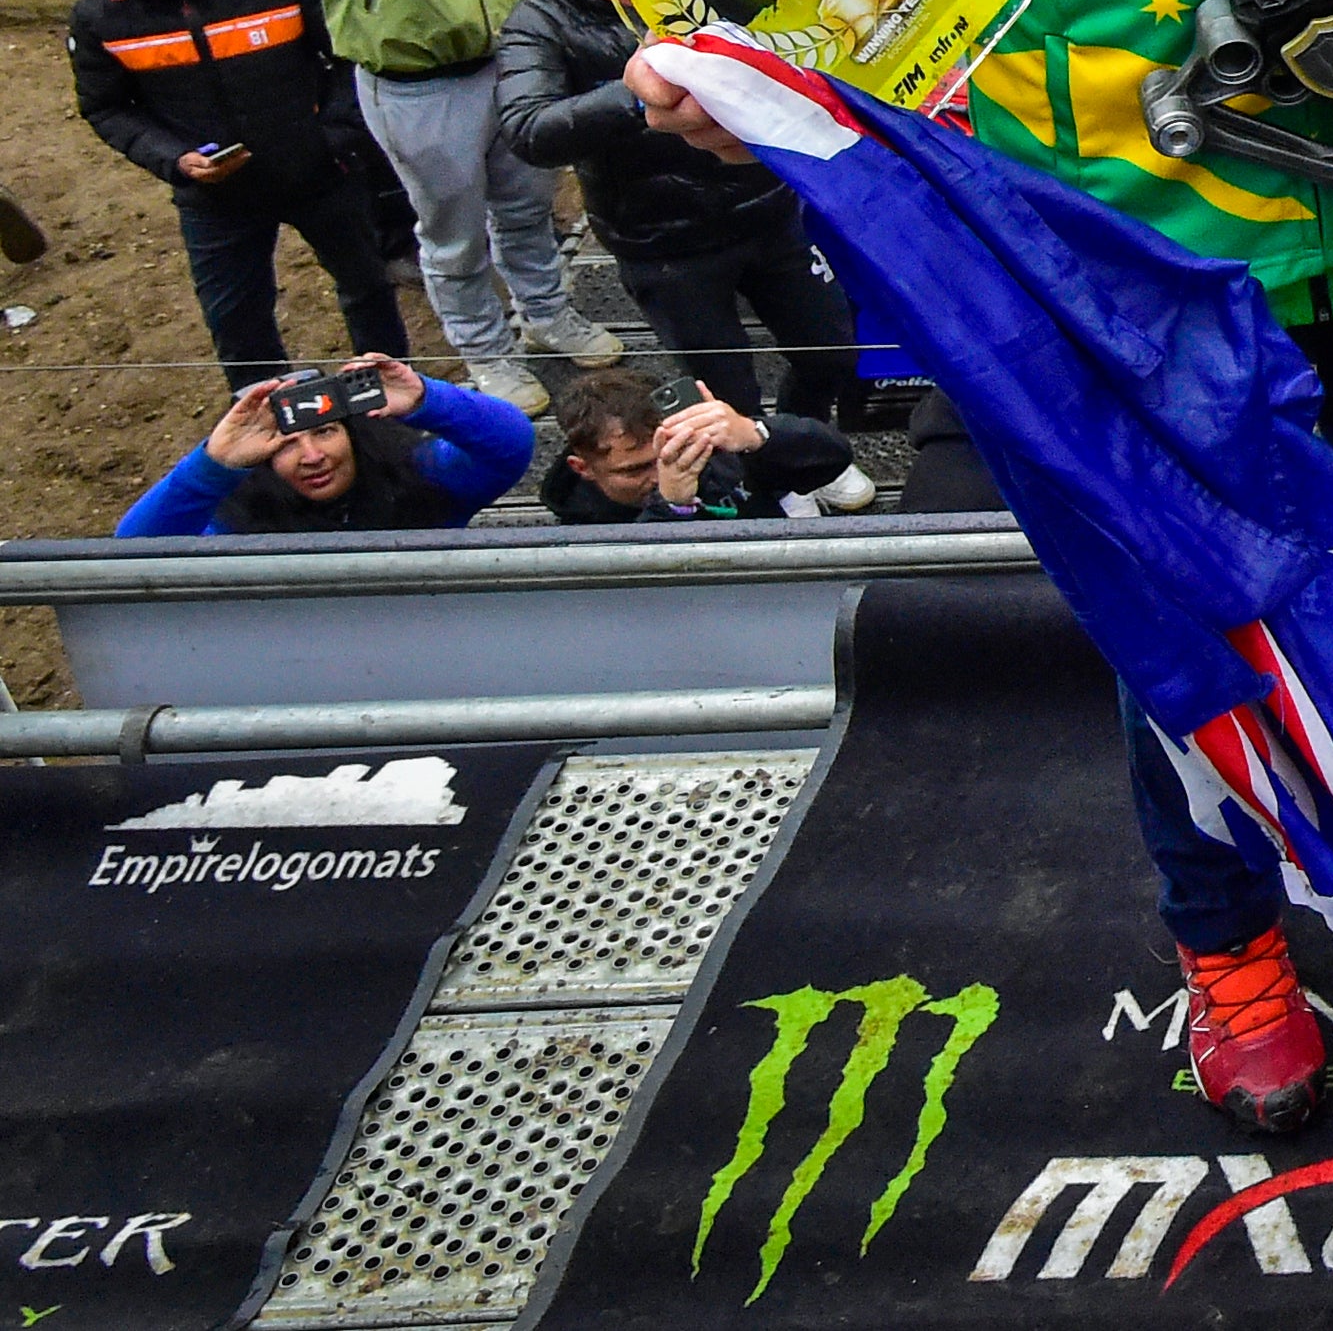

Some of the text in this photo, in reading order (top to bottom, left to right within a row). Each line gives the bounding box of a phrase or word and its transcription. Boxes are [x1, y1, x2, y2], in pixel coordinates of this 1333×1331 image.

[249, 30, 269, 46] 81
[855, 12, 902, 64] WINNING
[892, 62, 926, 106] FIM
[88, 840, 441, 894] Empirelogomats
